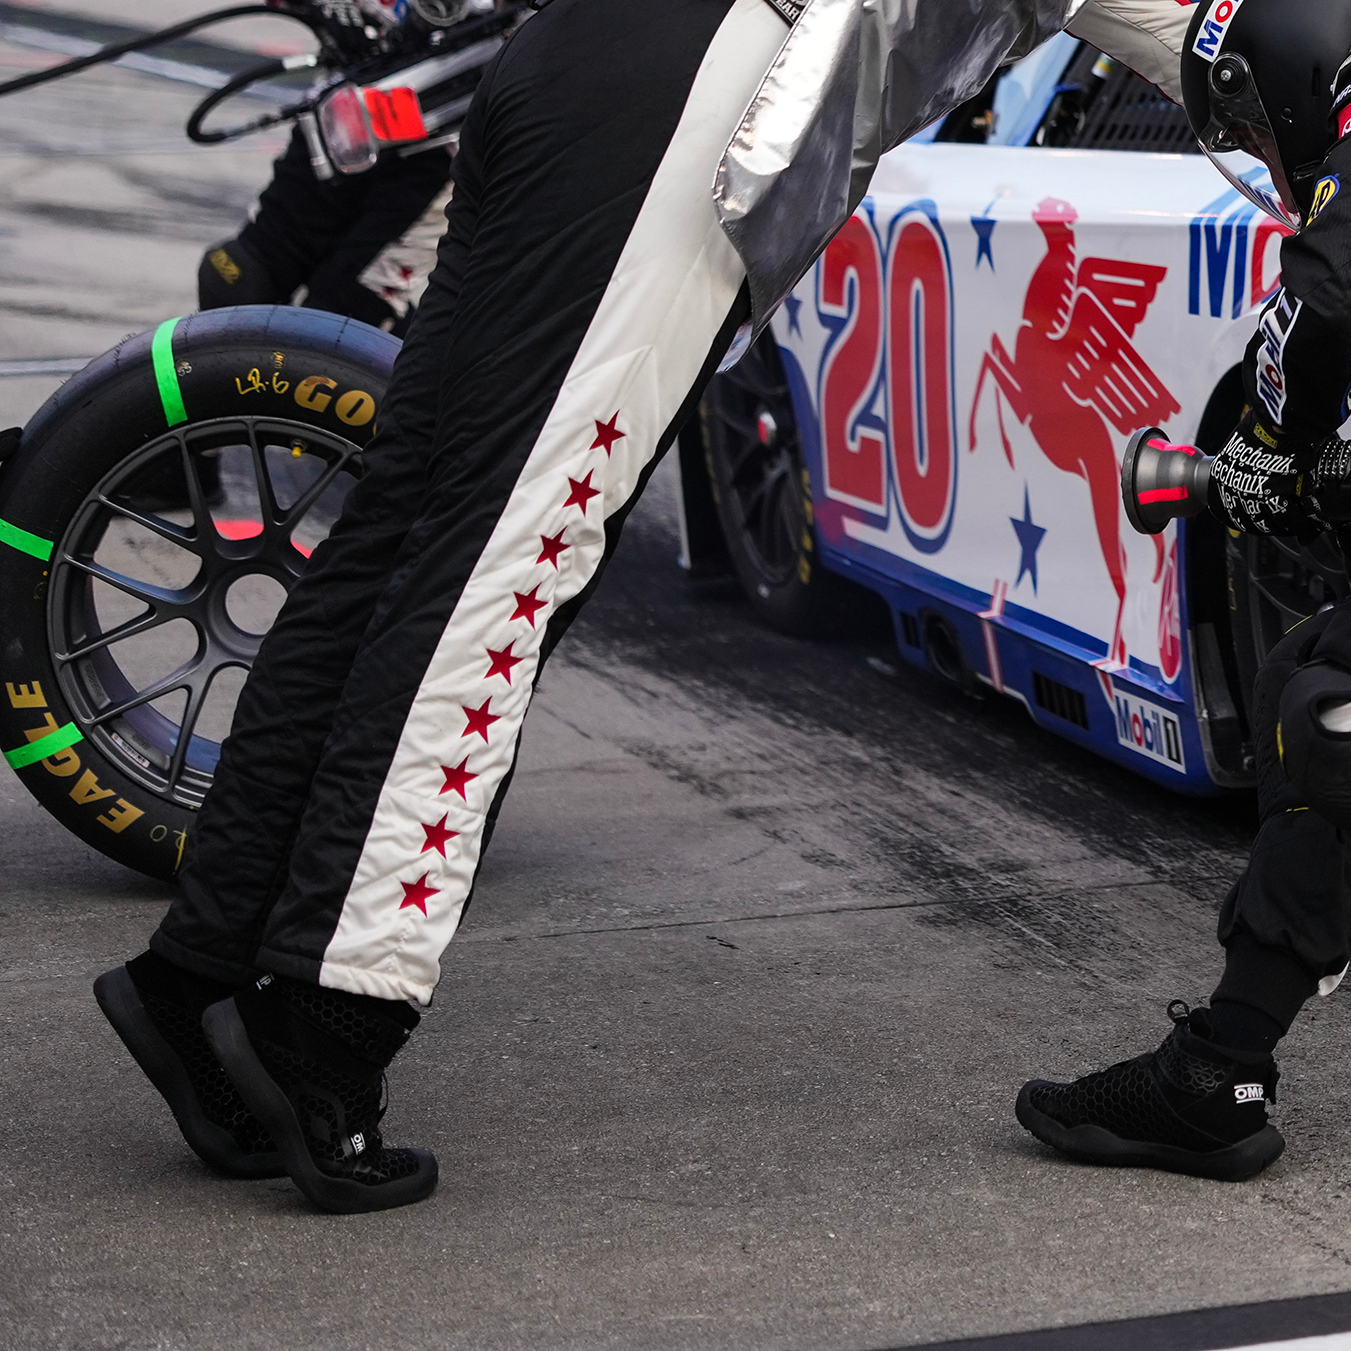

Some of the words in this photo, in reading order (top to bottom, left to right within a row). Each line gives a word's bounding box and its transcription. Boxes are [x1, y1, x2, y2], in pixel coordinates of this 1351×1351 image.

[818, 202, 957, 549] 20
[1115, 695, 1165, 757] Mobil
[1166, 718, 1178, 762] 1
[1234, 1085, 1264, 1101] OMP
